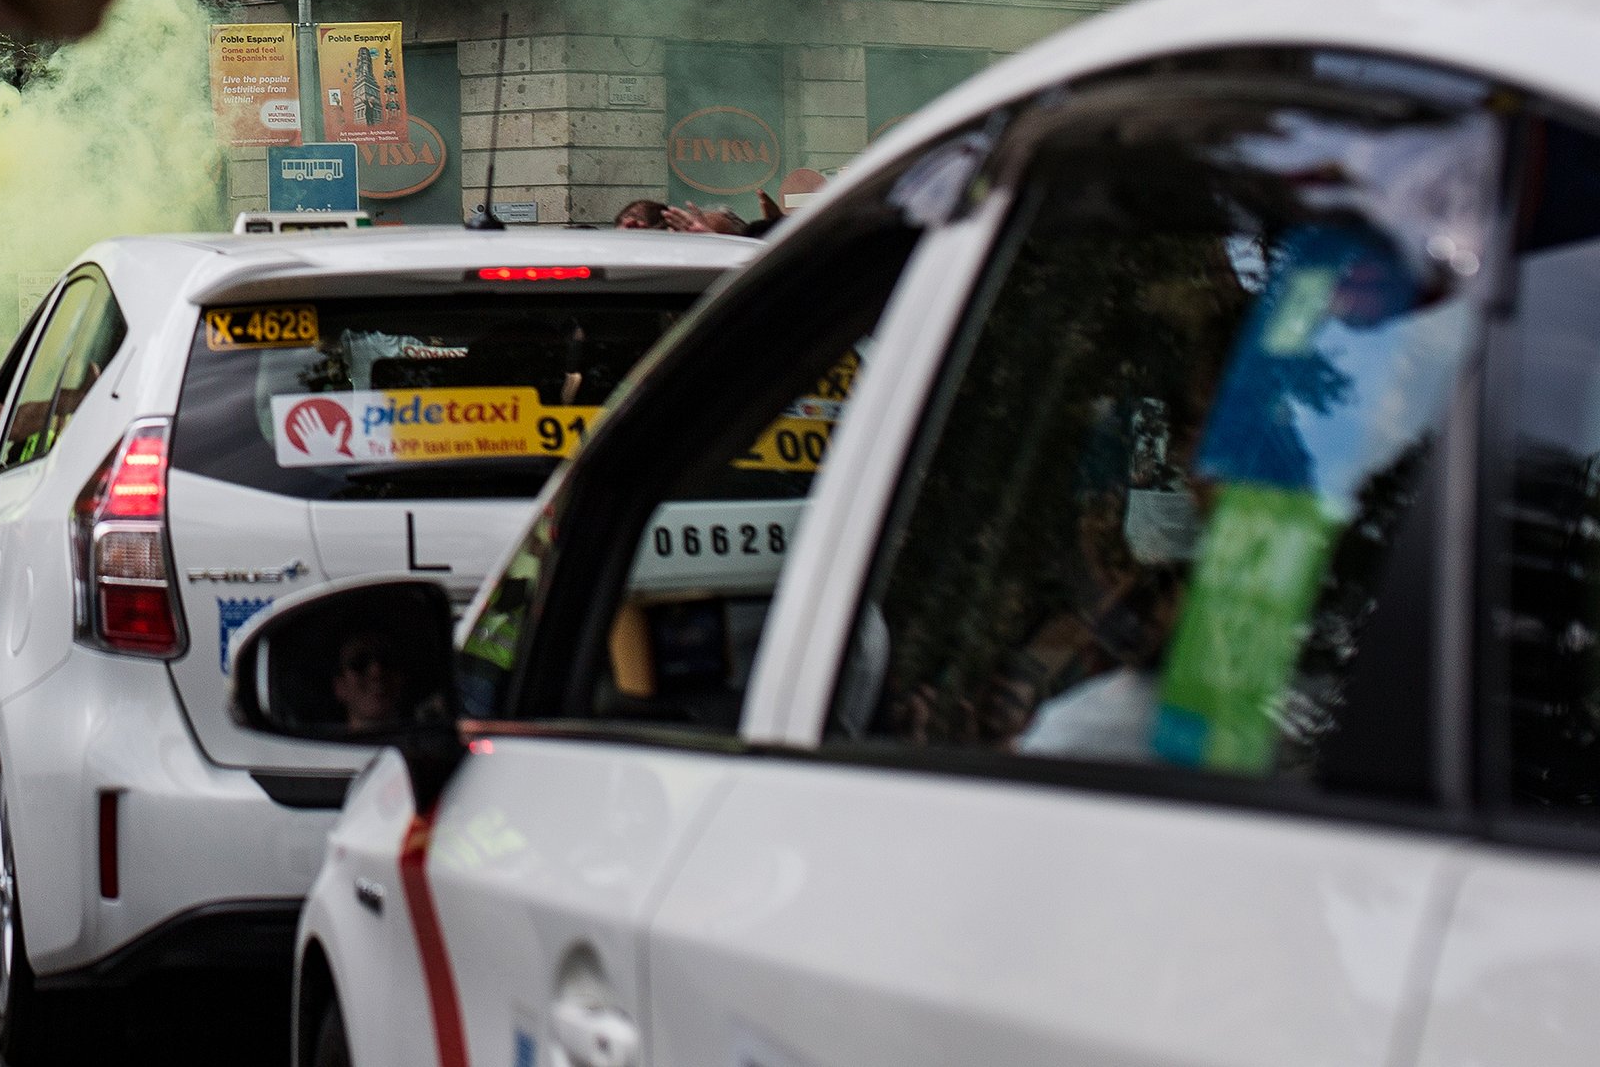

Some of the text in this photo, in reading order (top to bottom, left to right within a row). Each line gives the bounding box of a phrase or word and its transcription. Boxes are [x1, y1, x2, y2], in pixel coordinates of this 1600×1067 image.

[220, 35, 285, 45] Poble Espanyol
[327, 34, 391, 43] Poble Espanyol
[221, 46, 244, 54] Come
[236, 55, 268, 63] Spanish
[222, 76, 241, 84] Live
[259, 75, 290, 85] popular
[267, 85, 287, 93] from
[359, 142, 437, 166] VISSA
[674, 136, 773, 164] EIVISSA
[212, 309, 318, 345] X-4628
[361, 395, 521, 436] pidetaxi
[653, 523, 786, 557] 06628
